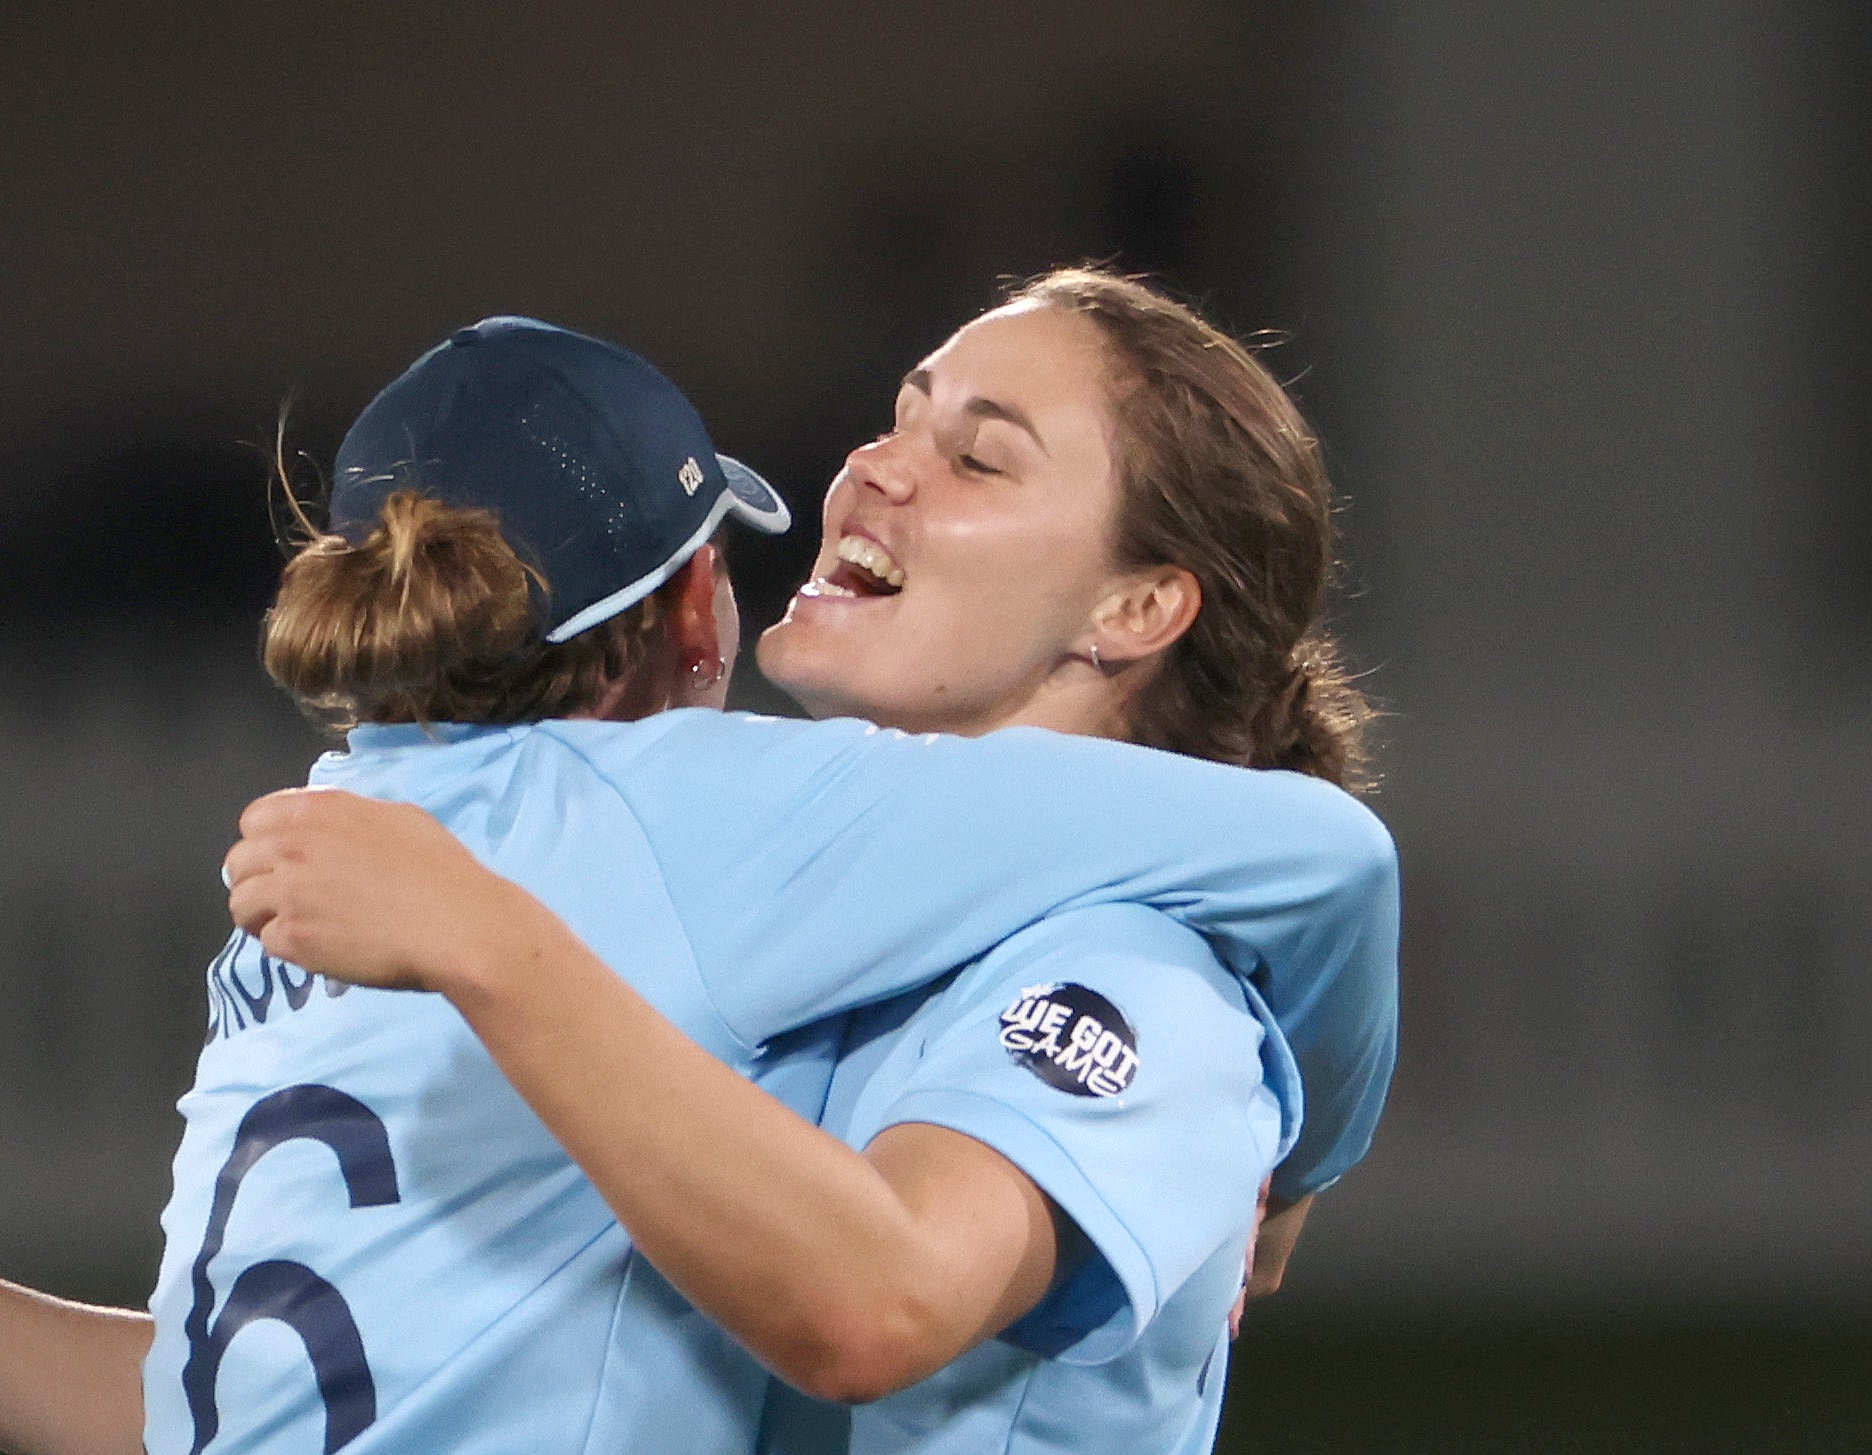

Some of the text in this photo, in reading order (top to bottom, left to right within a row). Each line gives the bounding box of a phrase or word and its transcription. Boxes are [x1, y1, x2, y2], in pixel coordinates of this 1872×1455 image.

[1000, 997, 1140, 1089] WE GOT
[1000, 1023, 1120, 1099] GAME
